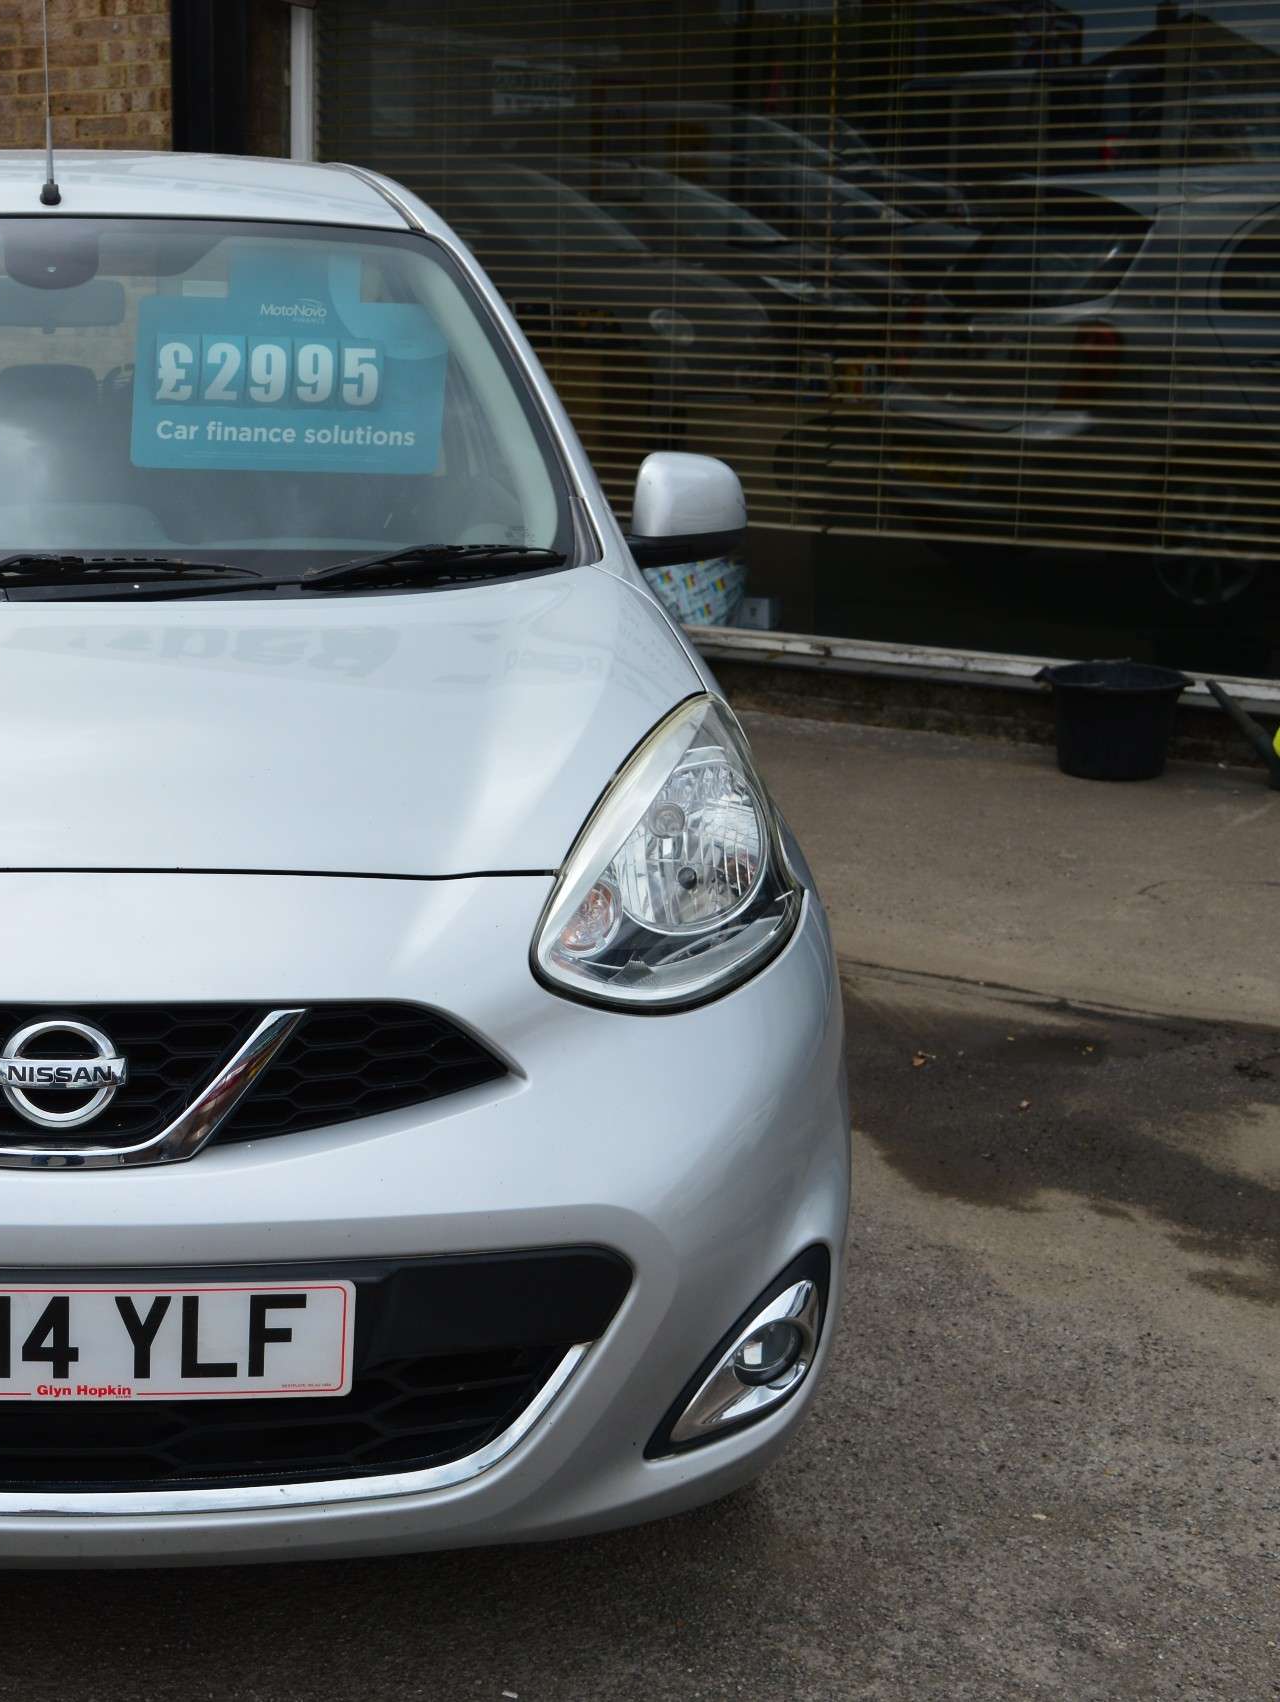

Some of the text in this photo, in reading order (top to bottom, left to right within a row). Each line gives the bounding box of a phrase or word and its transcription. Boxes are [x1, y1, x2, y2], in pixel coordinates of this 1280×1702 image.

[260, 303, 328, 318] MotoNovo
[155, 342, 379, 406] £2995
[156, 420, 416, 446] Car finance solutions
[7, 1065, 112, 1083] NISSAN
[114, 1292, 308, 1379] YLF
[36, 1384, 132, 1398] Glyn Hopkin
